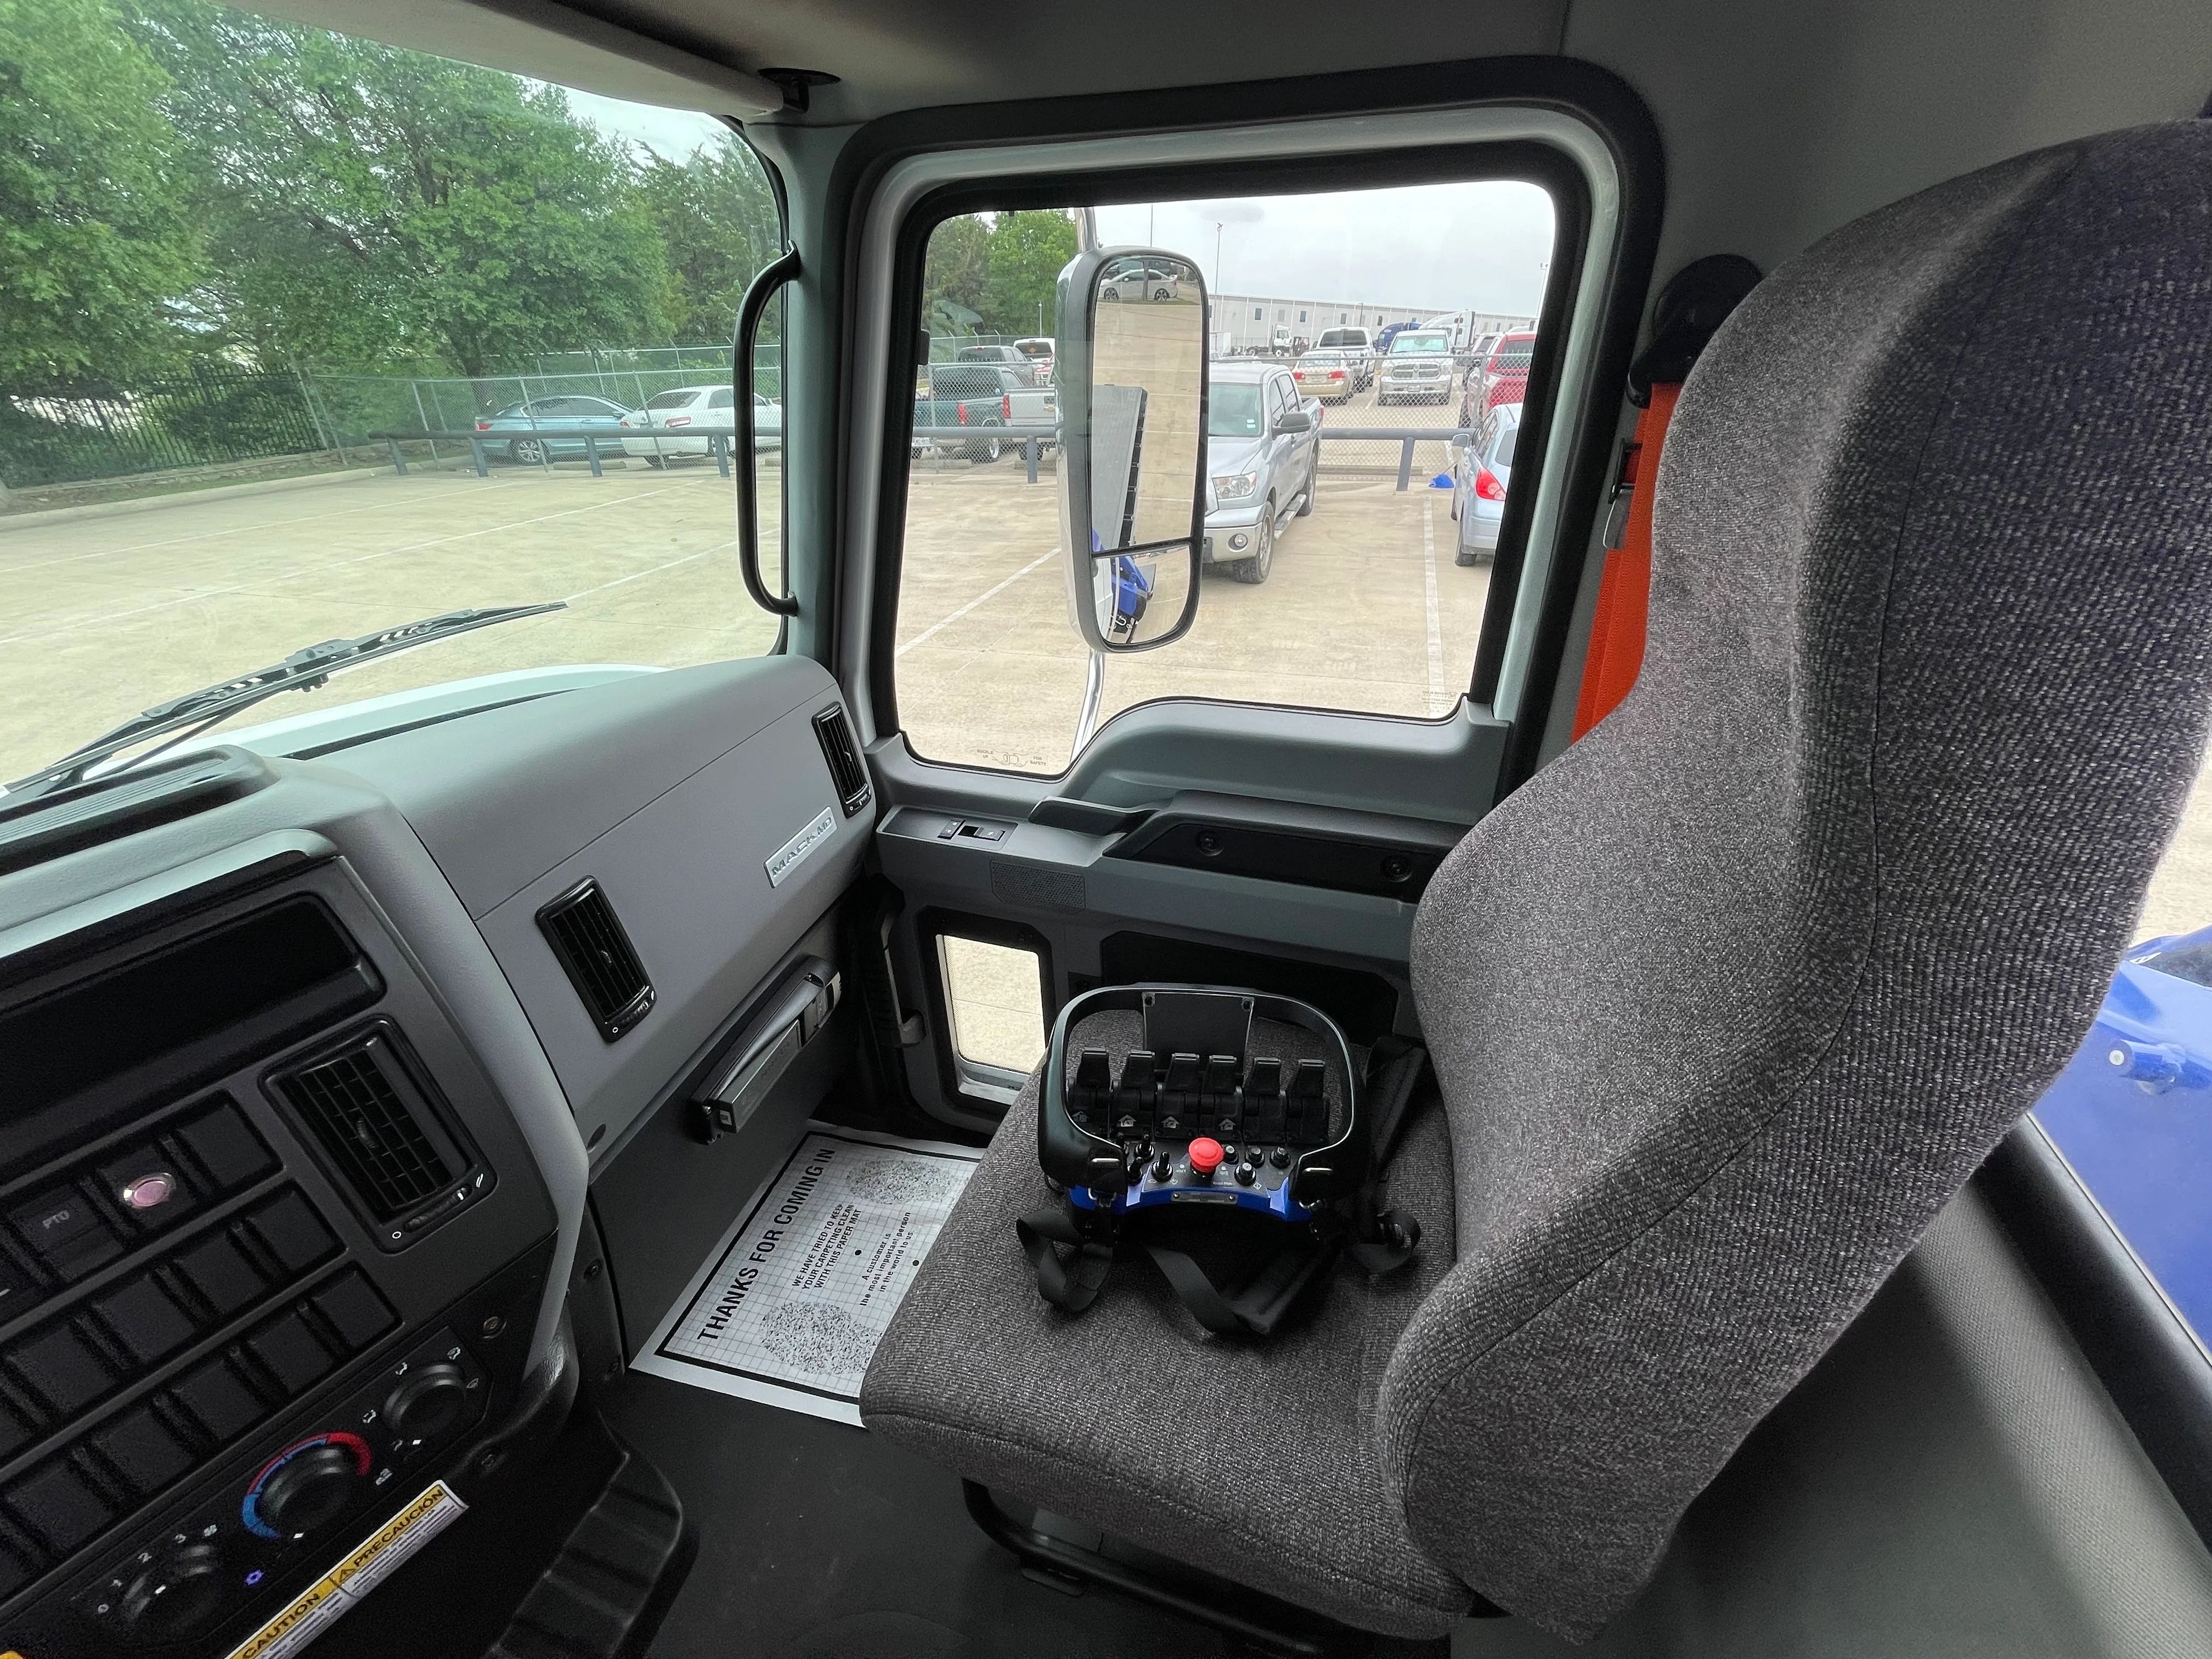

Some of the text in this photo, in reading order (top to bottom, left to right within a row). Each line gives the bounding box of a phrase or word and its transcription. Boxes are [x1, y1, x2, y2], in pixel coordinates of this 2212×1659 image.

[771, 833, 816, 878] MACK
[42, 1210, 70, 1229] PTO
[697, 1149, 836, 1340] THANKS FOR COMING IN
[792, 1204, 844, 1286] WE HAVE TRIED TO KEEP
[802, 1204, 855, 1289] YOUR CARPETING CLEAN
[814, 1209, 861, 1288] WITH THIS PAPER MAT
[859, 1212, 911, 1306] the most important person
[866, 1240, 887, 1273] customer
[883, 1271, 894, 1283] the
[890, 1250, 904, 1269] world
[353, 1488, 444, 1567] PRECAUCIÓN
[242, 1592, 320, 1659] CAUTION
